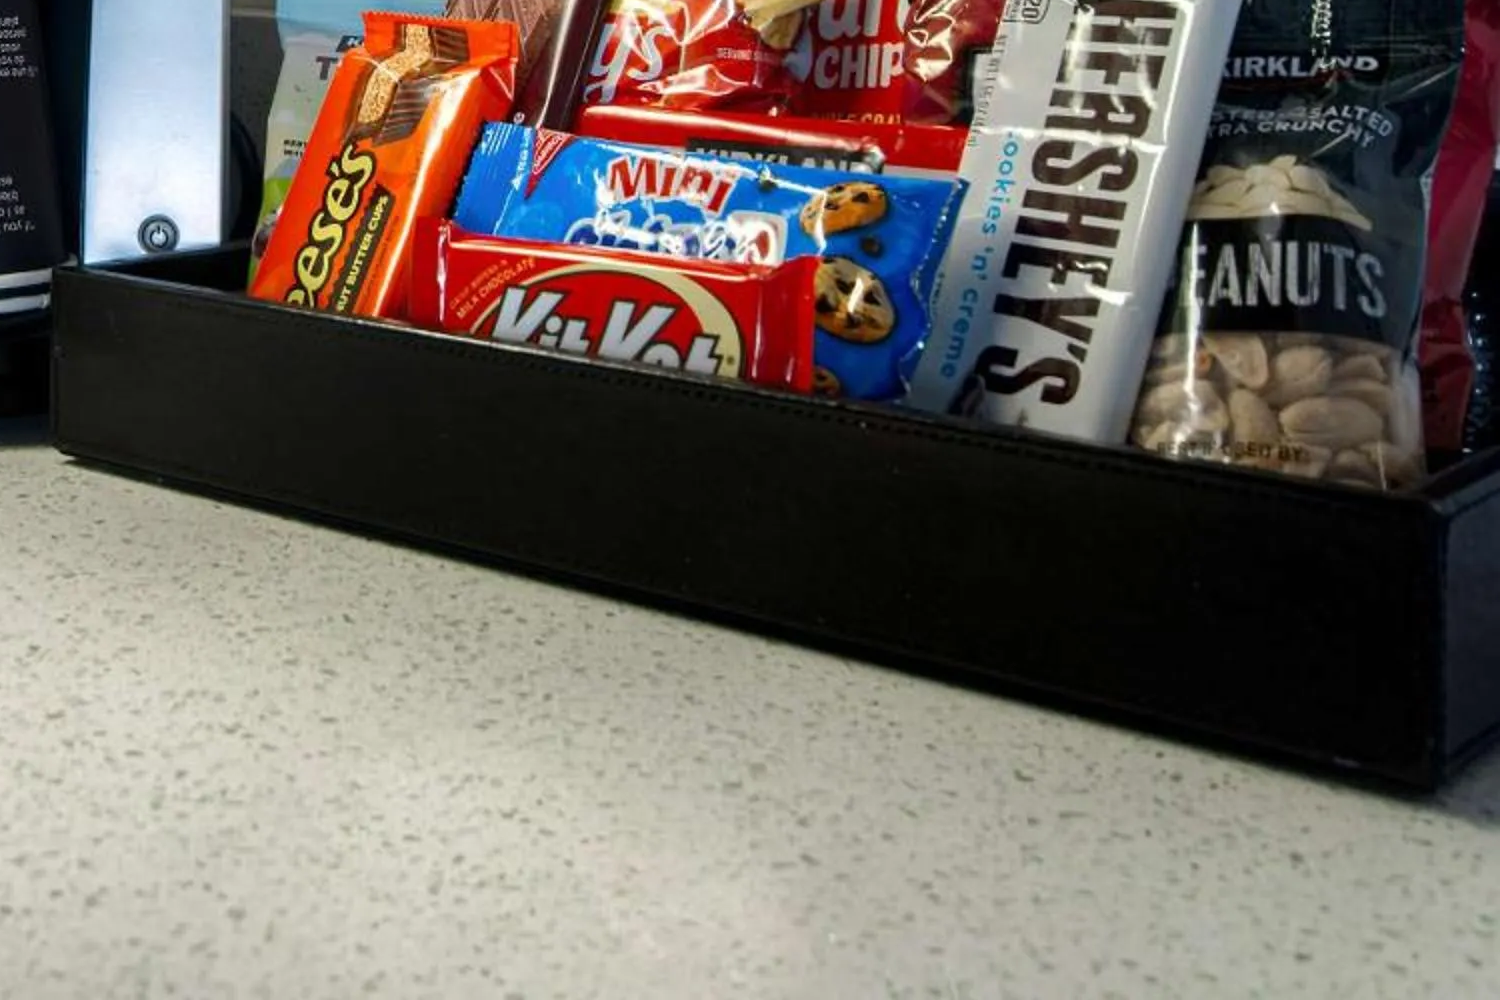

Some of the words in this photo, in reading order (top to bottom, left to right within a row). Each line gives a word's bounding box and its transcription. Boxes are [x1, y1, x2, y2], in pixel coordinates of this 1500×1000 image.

[814, 42, 904, 89] CHIP
[1256, 118, 1377, 148] CRUNCHY
[1308, 105, 1394, 137] SALTED
[287, 145, 373, 308] ese's
[351, 232, 373, 286] BUTTER
[368, 196, 389, 232] CUPS
[1180, 240, 1387, 318] EANUTS
[940, 288, 979, 378] creme
